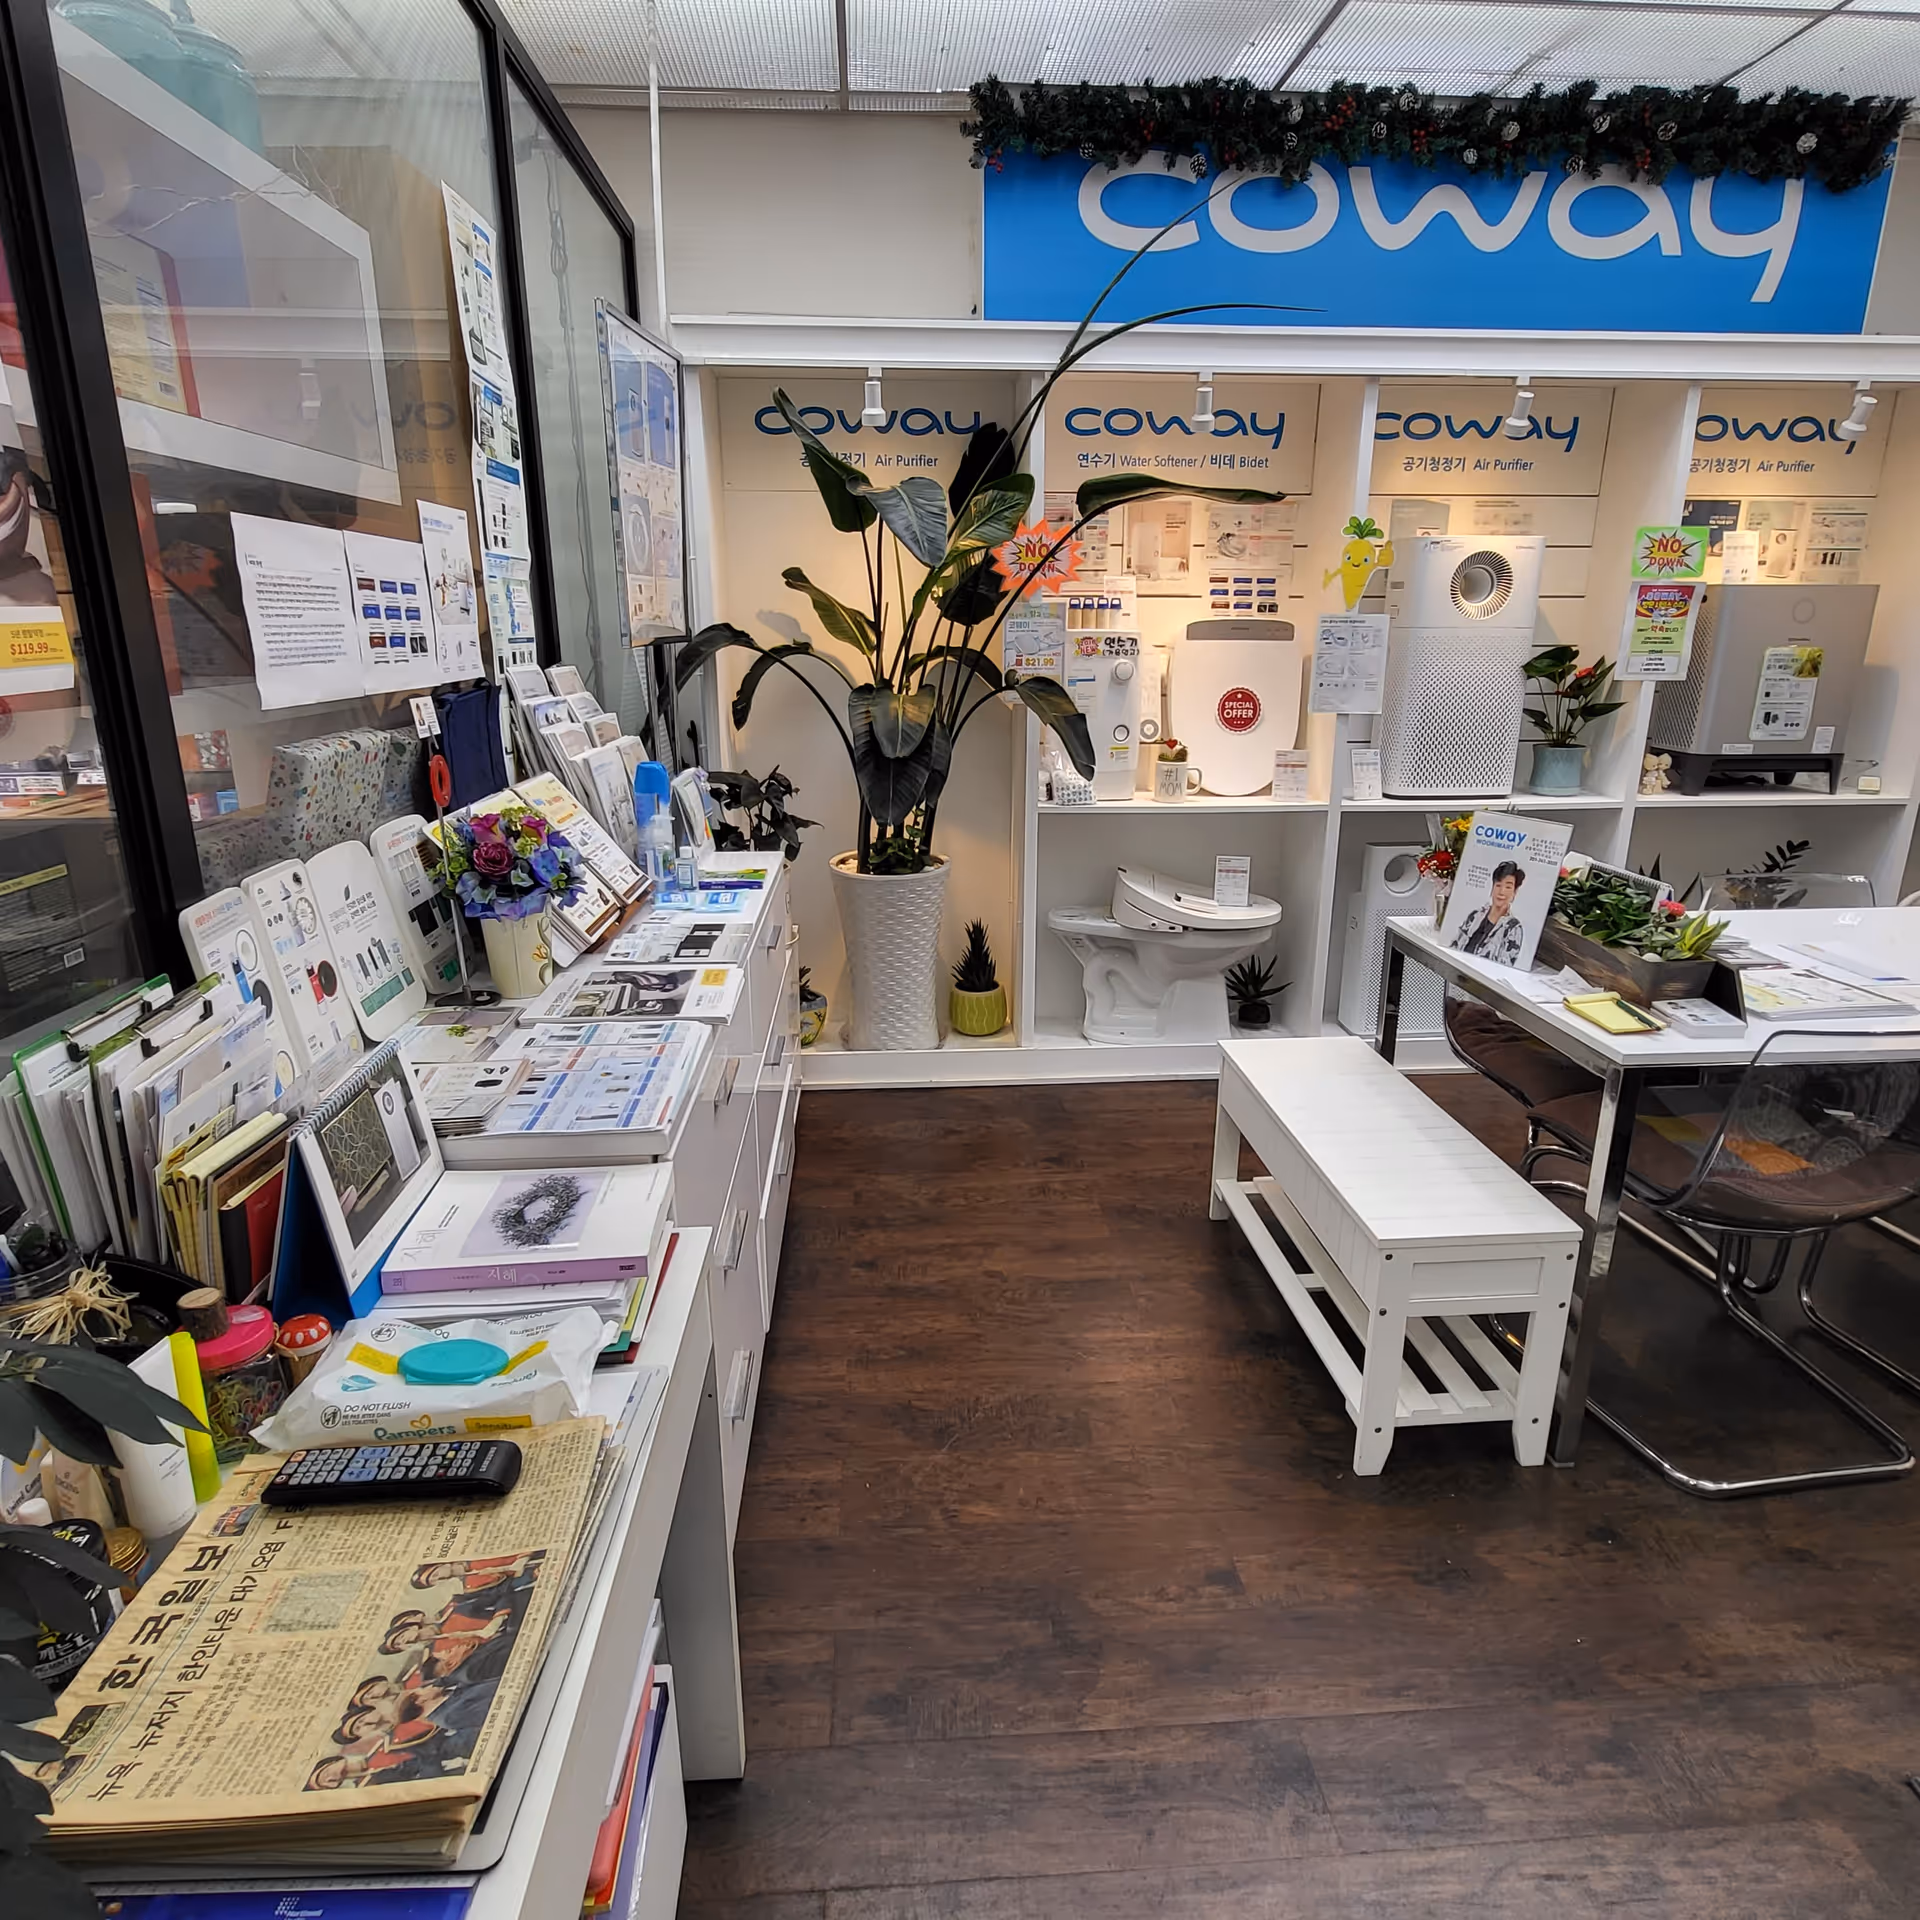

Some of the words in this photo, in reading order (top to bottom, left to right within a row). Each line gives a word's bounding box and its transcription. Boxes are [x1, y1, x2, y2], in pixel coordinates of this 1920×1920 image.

[875, 454, 892, 467] Air
[896, 453, 939, 468] Purifier
[1077, 453, 1116, 468] 연수기
[1120, 455, 1151, 468] Water
[1154, 454, 1198, 468] Softener
[1200, 455, 1207, 468] /
[1210, 453, 1235, 470] 비데
[1239, 456, 1269, 468] Bidet
[1402, 456, 1466, 472] 공기청정기
[1473, 459, 1490, 471] Air
[1494, 458, 1534, 471] Purifier
[1690, 458, 1750, 473] 공기청정기
[1757, 461, 1773, 472] Air
[1776, 460, 1815, 473] Purifier
[1025, 543, 1051, 558] NO
[1657, 538, 1682, 553] NO
[1019, 562, 1055, 572] DON
[1649, 557, 1684, 567] DOWN
[10, 642, 49, 655] $119.99
[1104, 636, 1138, 648] 연수기
[1025, 658, 1055, 666] $21.99
[1224, 701, 1254, 709] SPECIAL
[1224, 709, 1254, 718] OFFER
[1164, 768, 1179, 781] #1
[1160, 782, 1183, 796] MOM
[487, 1267, 517, 1283] 지혜
[344, 1404, 359, 1413] DO
[361, 1403, 380, 1411] NOT
[382, 1402, 411, 1411] FLUSH
[373, 1424, 457, 1441] Pampers
[97, 1543, 234, 1693] 한국일보
[177, 1607, 243, 1683] 한인타운
[229, 1541, 287, 1602] 대기오염
